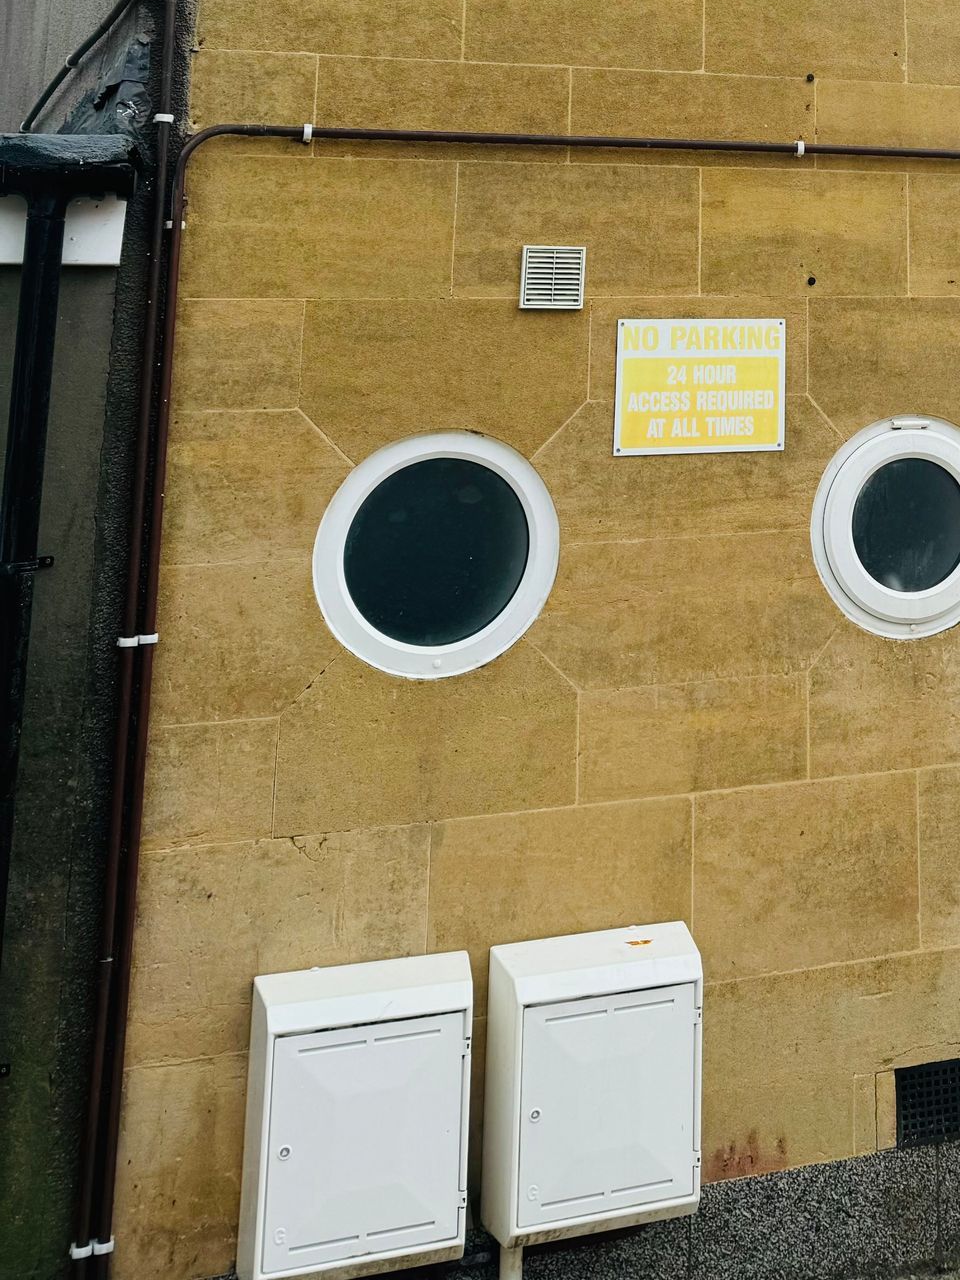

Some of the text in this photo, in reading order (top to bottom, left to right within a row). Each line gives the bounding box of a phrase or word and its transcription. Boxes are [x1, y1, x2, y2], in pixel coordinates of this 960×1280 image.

[623, 325, 780, 351] NO PARKING
[667, 364, 737, 385] 24 HOUR
[627, 389, 774, 413] ACCESS REQUIRED
[646, 416, 754, 439] AT ALL TIMES
